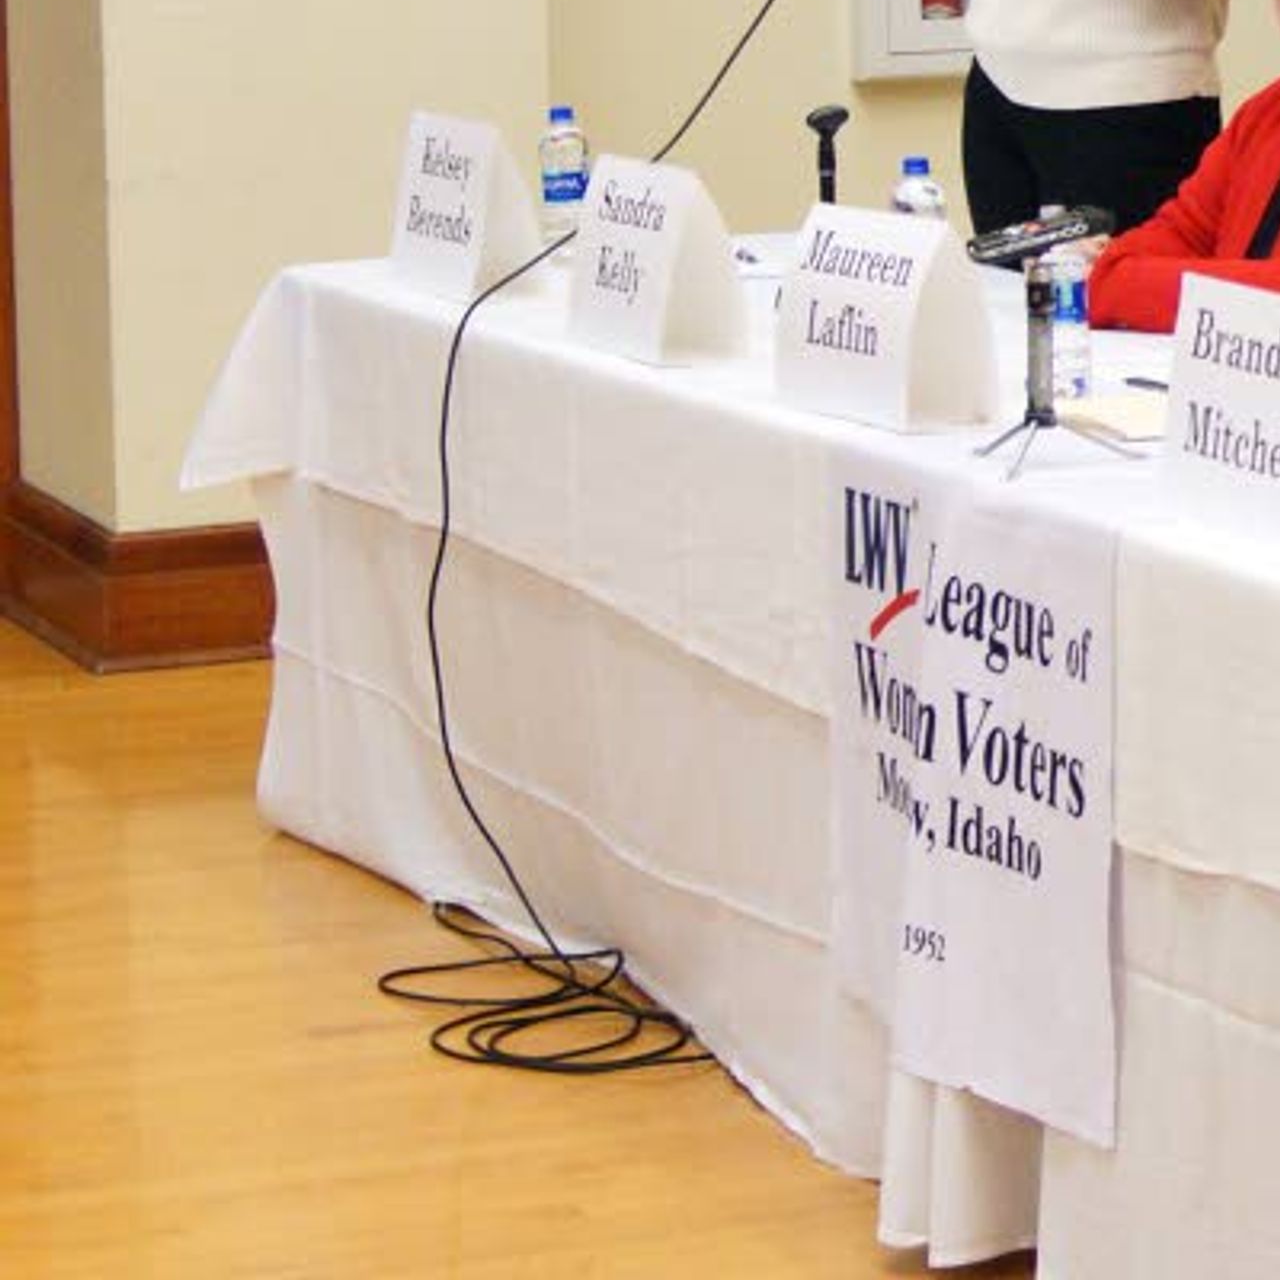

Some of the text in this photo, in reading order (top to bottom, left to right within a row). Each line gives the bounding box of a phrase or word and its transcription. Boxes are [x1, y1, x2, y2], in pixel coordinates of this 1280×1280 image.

[421, 136, 472, 193] Kelsey
[598, 179, 666, 231] Sandra
[595, 245, 646, 305] Kelly
[801, 230, 914, 288] Maureen
[805, 300, 879, 357] Laflin
[845, 487, 911, 593] LWV
[924, 542, 1092, 683] League of
[953, 689, 1086, 819] Voters
[946, 796, 1042, 880] Idaho
[904, 923, 946, 962] 1952
